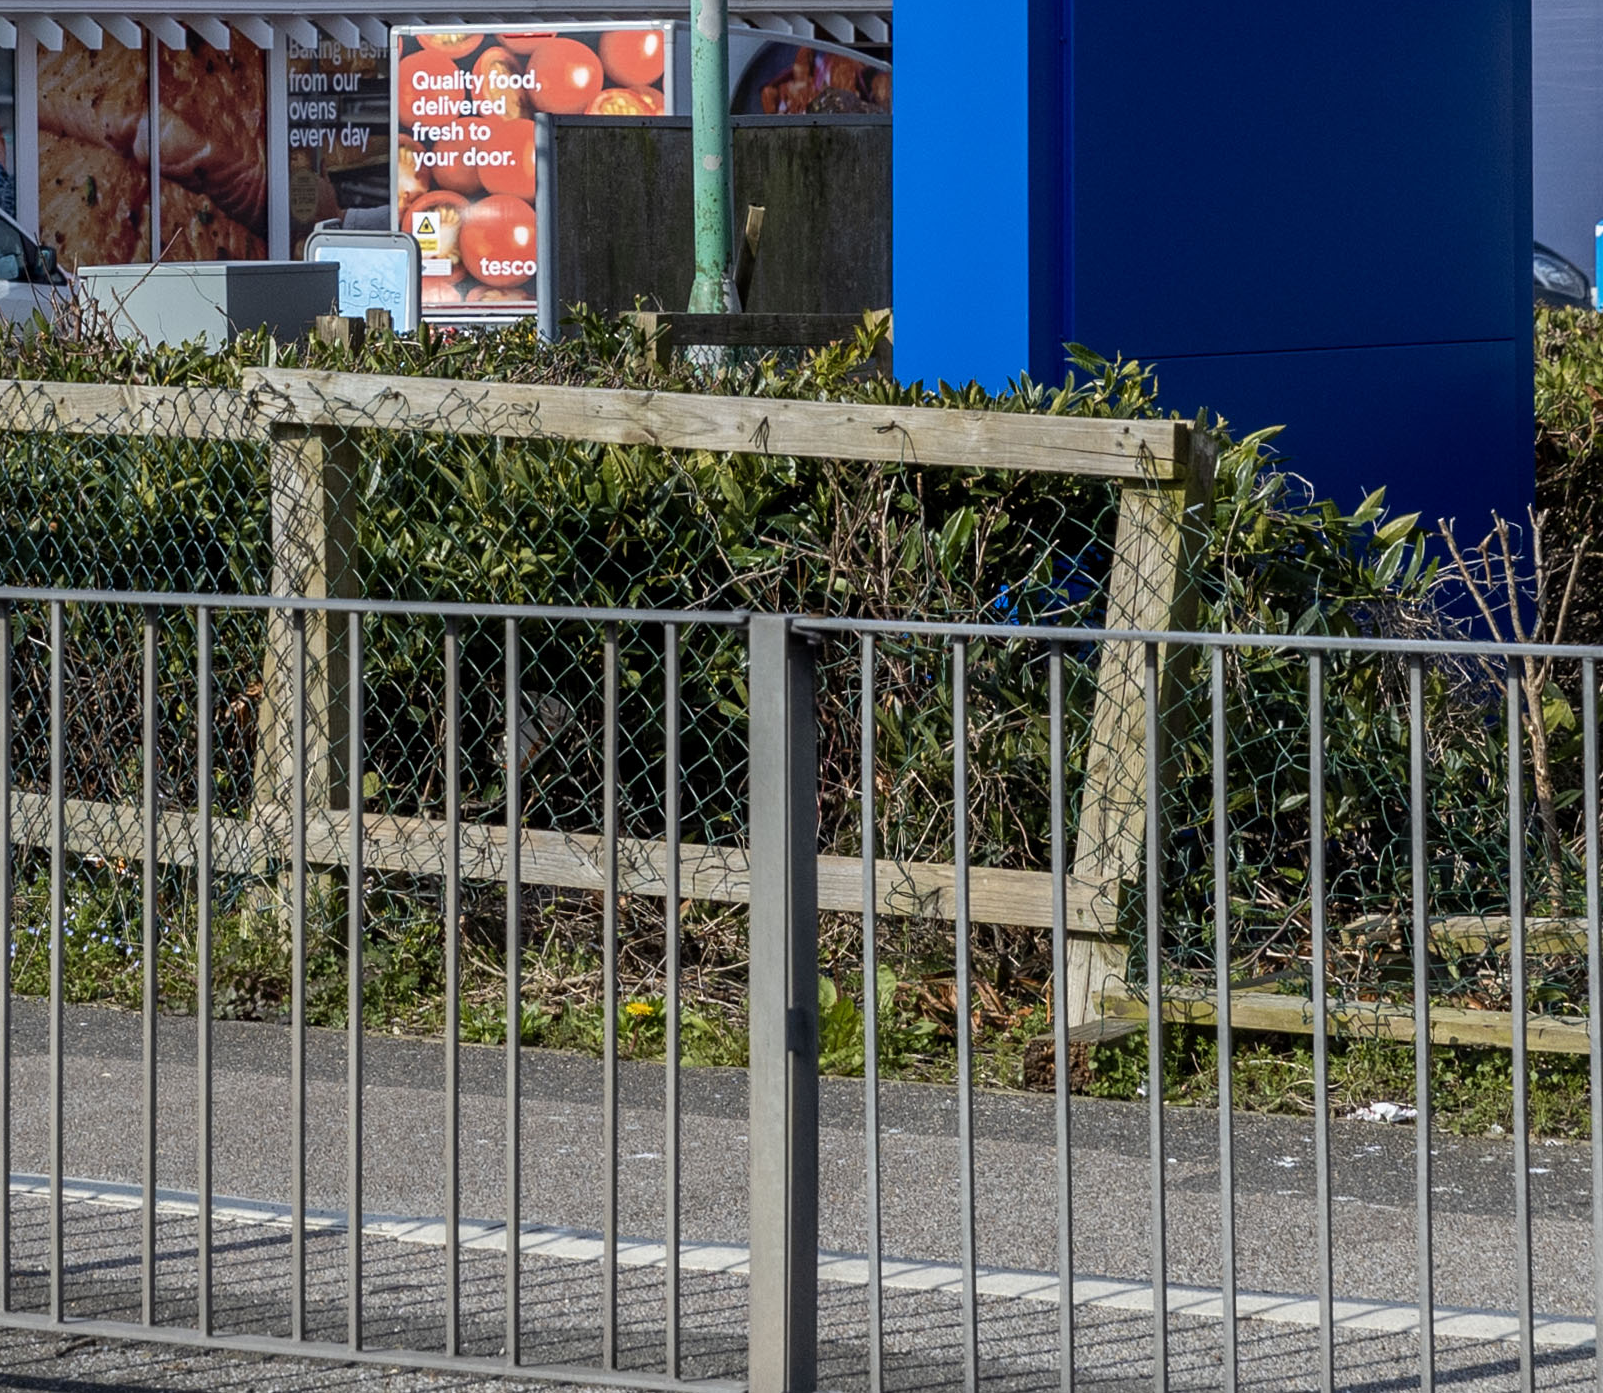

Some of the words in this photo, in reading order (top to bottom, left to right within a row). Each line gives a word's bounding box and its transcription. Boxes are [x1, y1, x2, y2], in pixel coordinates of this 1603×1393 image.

[289, 67, 328, 92] from
[333, 72, 361, 92] our
[412, 70, 484, 94] Quality
[488, 69, 541, 92] food,
[289, 100, 337, 120] ovens
[412, 95, 506, 115] delivered
[289, 127, 336, 153] every
[341, 122, 370, 153] day
[412, 121, 464, 141] fresh
[468, 122, 491, 141] to
[412, 151, 459, 172] your
[462, 146, 516, 166] door.
[480, 257, 536, 276] tesco
